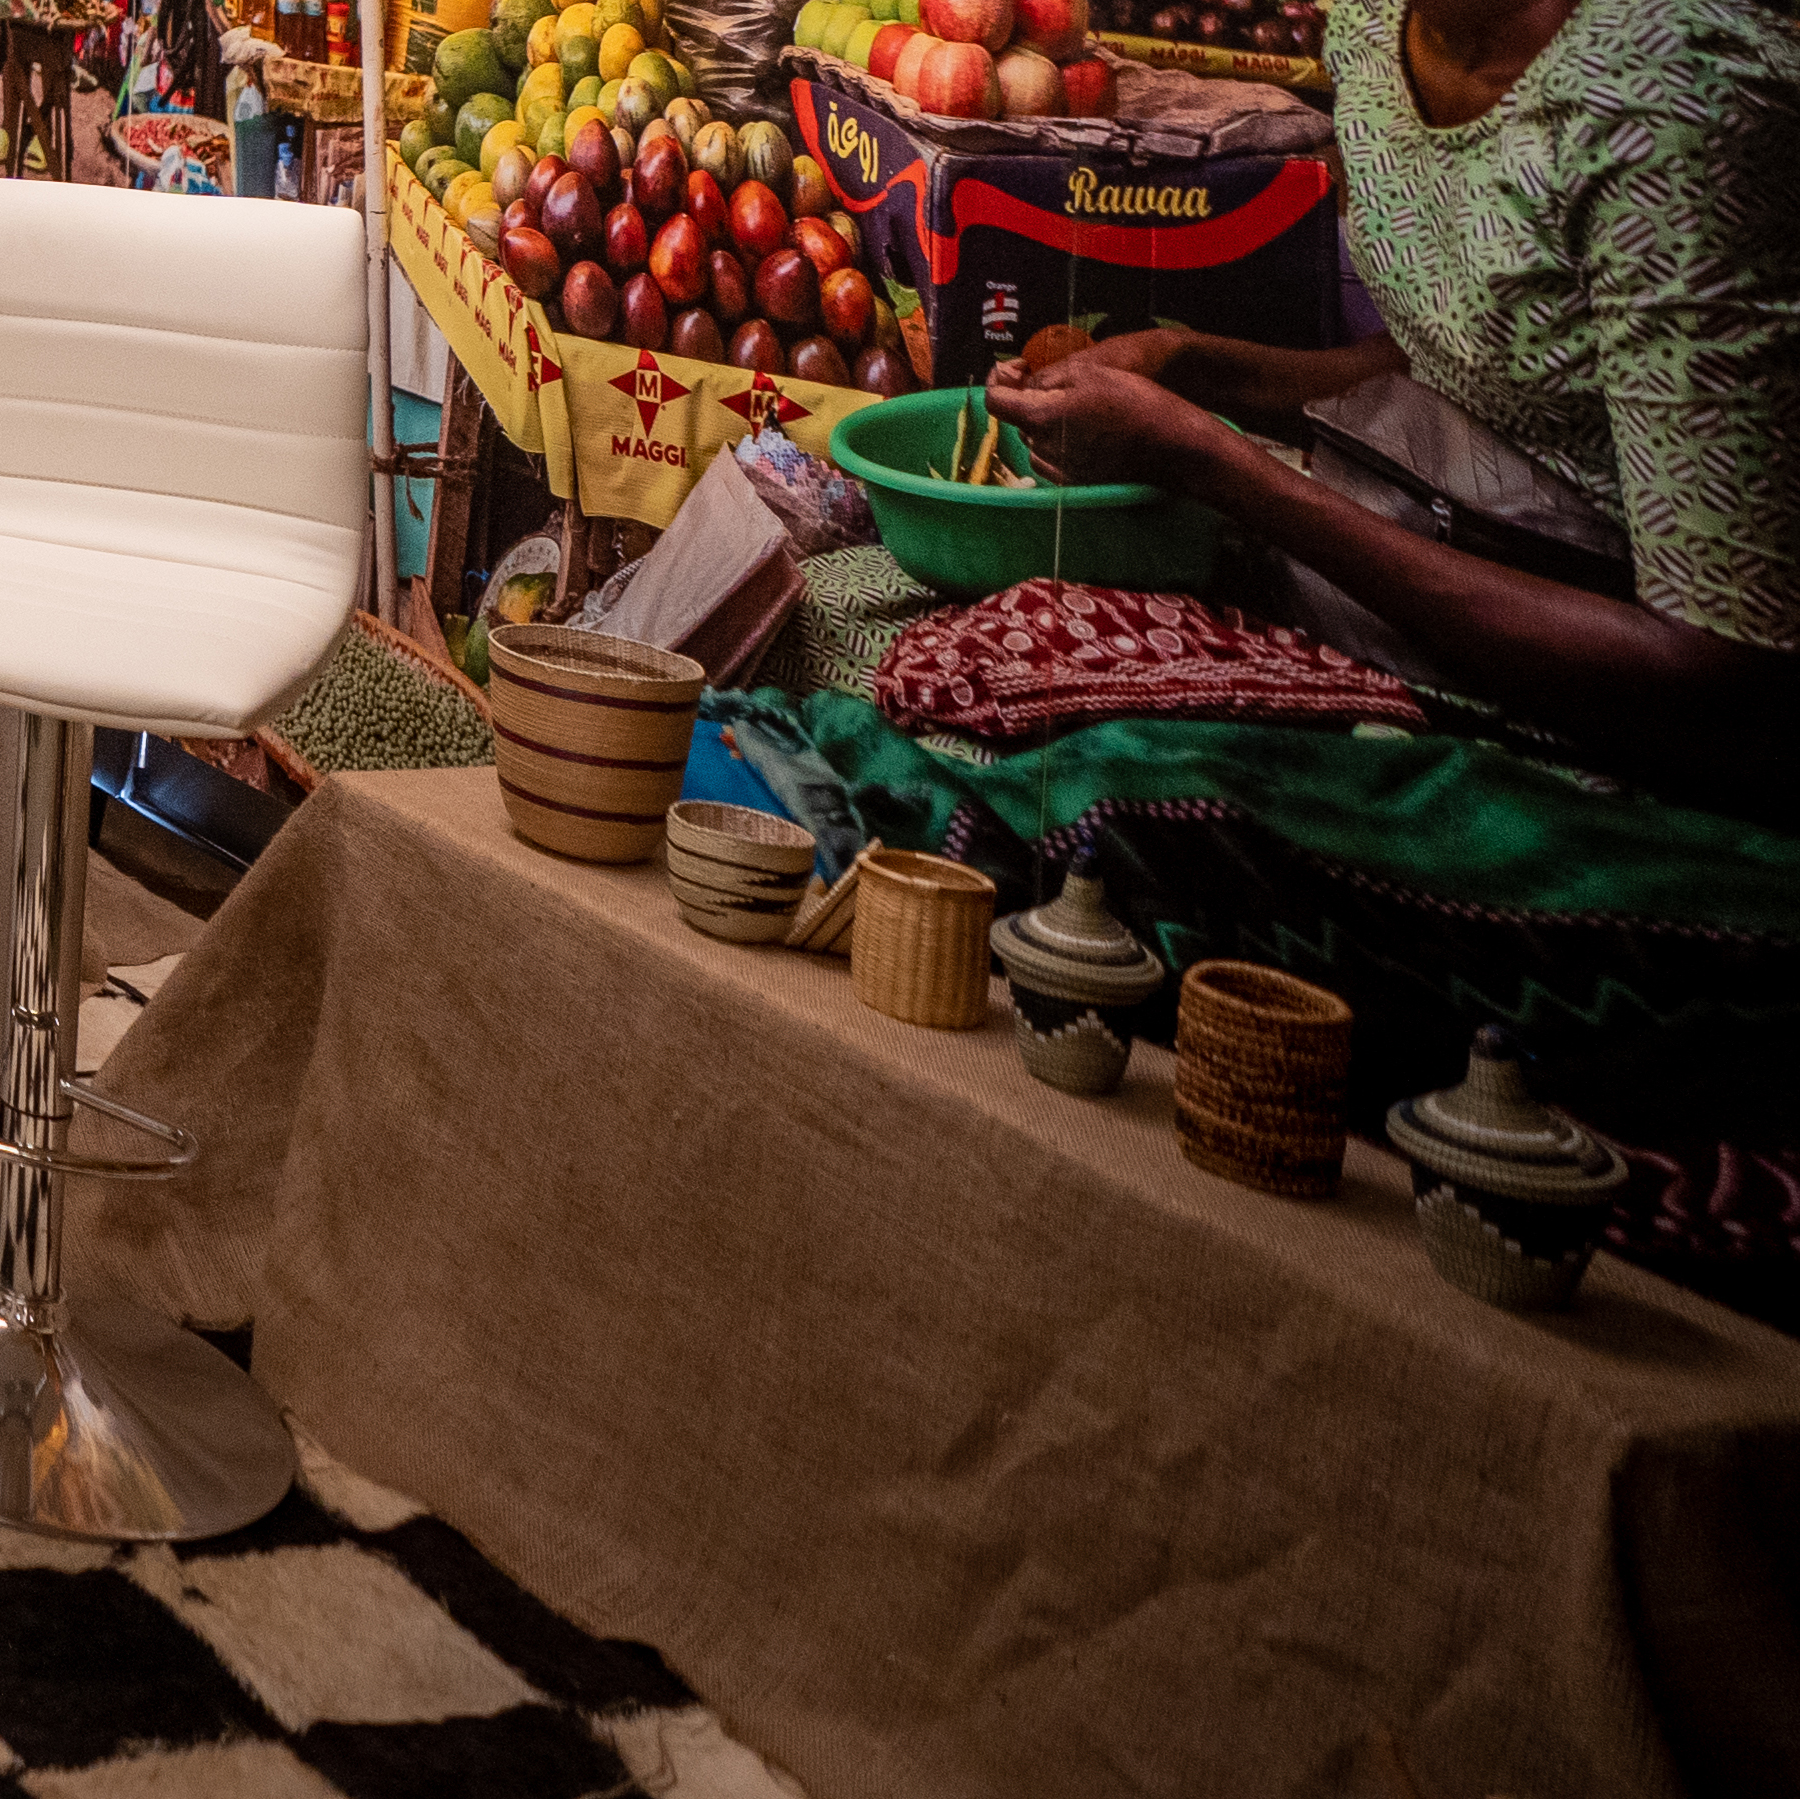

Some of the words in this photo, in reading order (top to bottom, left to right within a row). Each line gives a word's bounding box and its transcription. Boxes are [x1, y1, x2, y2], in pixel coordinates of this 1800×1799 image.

[1064, 167, 1212, 218] Rawaa
[984, 329, 1015, 342] Fresh
[611, 436, 687, 468] MAGGI
